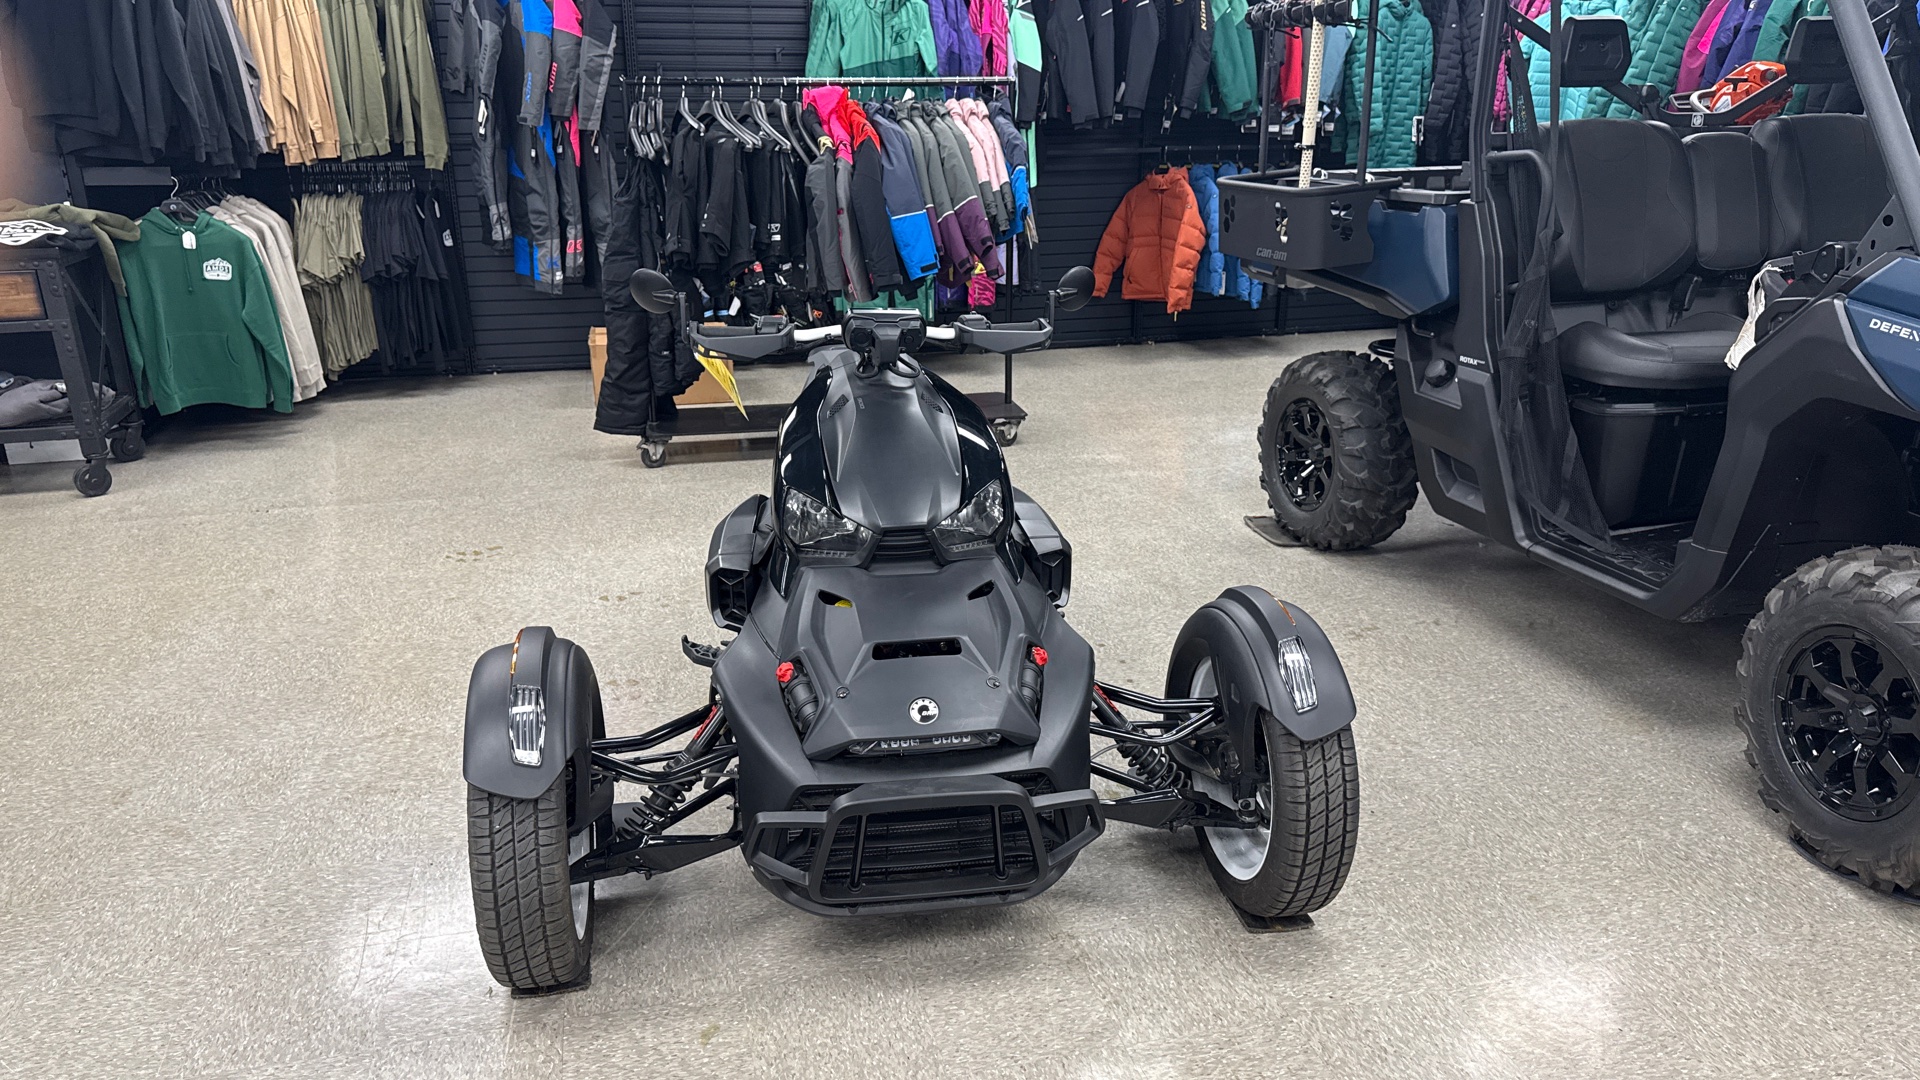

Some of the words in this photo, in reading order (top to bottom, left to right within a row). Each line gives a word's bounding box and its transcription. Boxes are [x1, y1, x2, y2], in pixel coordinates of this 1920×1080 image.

[549, 61, 558, 93] Klim
[1256, 247, 1288, 261] can-am
[1459, 355, 1478, 366] ROTAX
